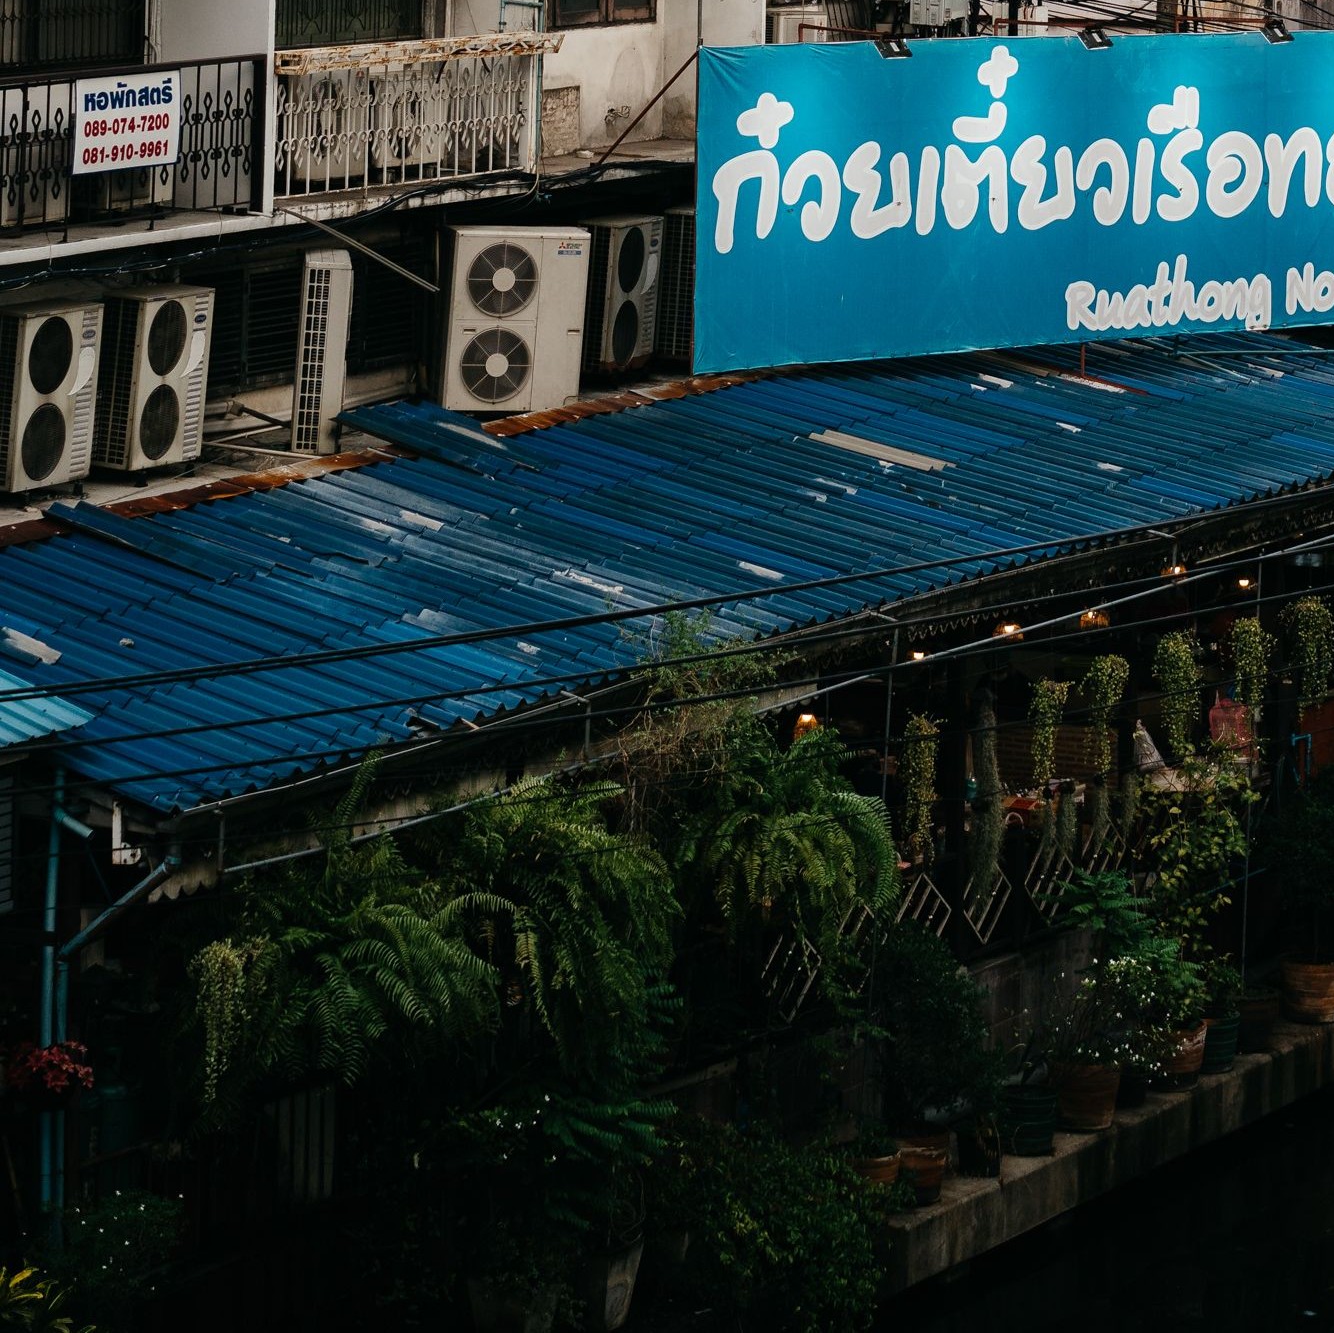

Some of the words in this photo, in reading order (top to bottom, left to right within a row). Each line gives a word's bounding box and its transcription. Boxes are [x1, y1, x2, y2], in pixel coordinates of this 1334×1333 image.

[84, 78, 173, 112] หอพักสตรี
[84, 113, 169, 137] 089-074-7200
[82, 140, 169, 164] 081-910-9961
[1064, 253, 1273, 331] Ruathong
